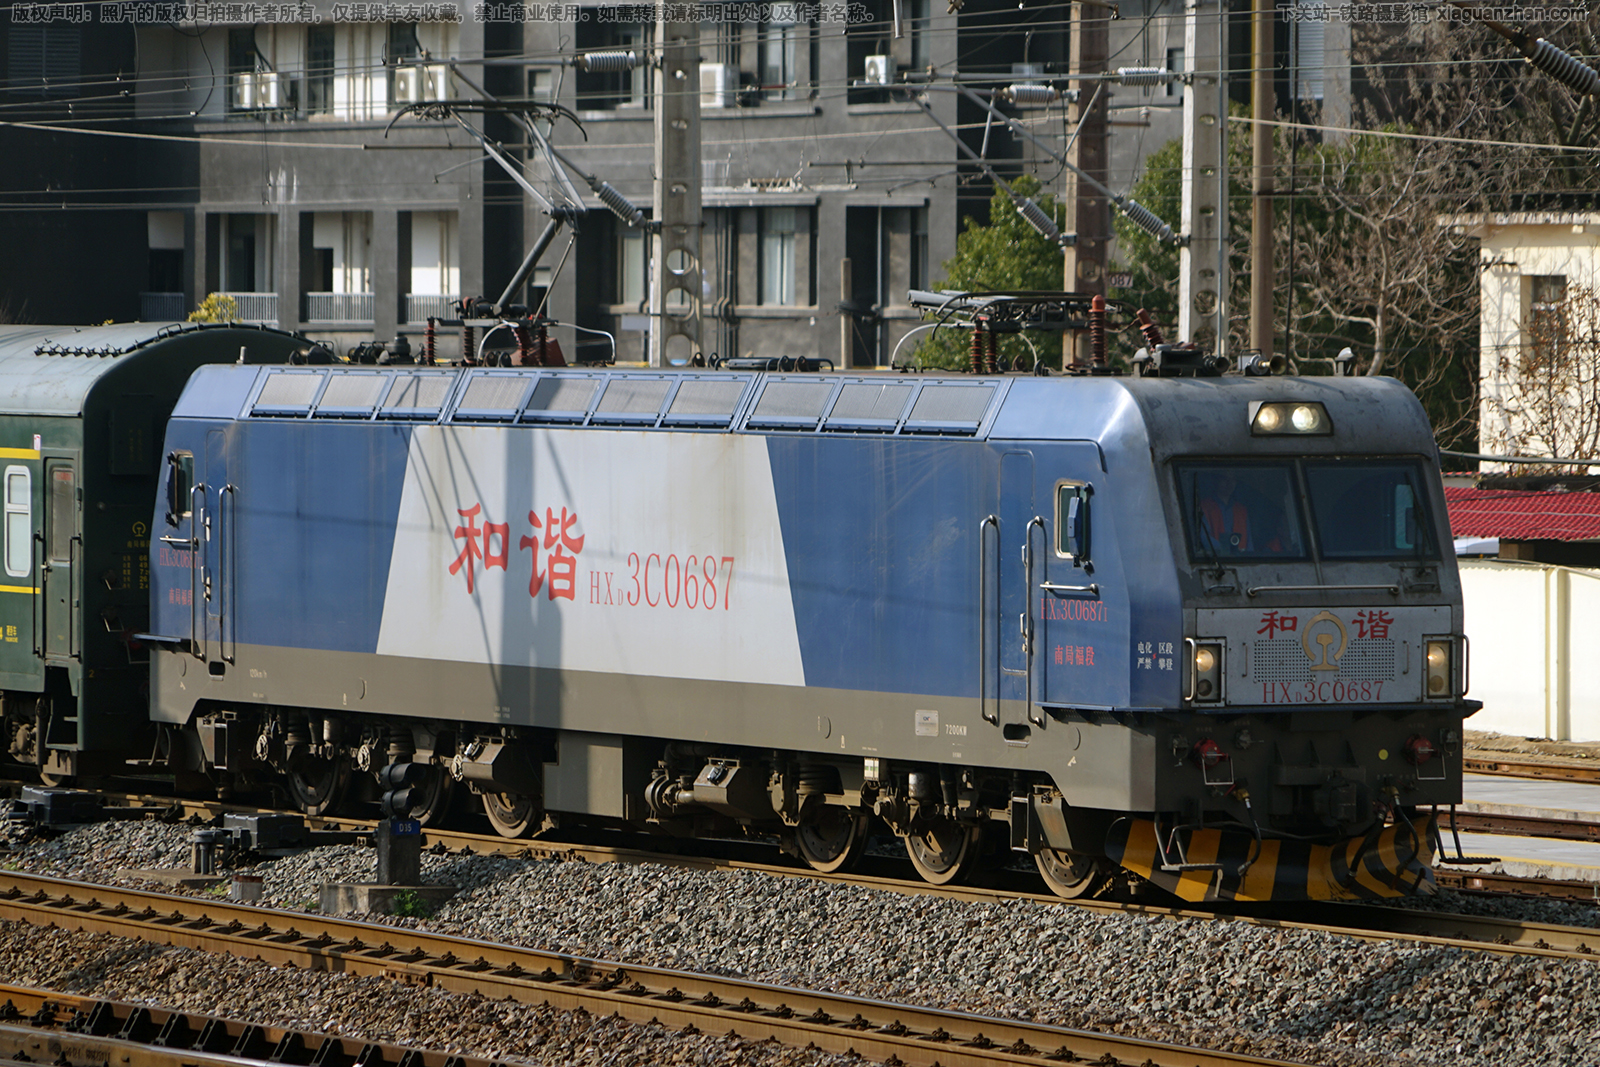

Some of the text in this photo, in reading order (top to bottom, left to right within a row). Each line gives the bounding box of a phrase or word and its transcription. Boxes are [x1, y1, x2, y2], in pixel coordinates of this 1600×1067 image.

[449, 503, 735, 611] 和谐 HXD3C0687
[1256, 610, 1394, 640] 和 谐
[1054, 644, 1096, 667] 南局福段
[1137, 641, 1174, 655] 电化 区段
[1137, 657, 1173, 671] 严禁 攀登
[1262, 681, 1385, 703] HXD3C0687
